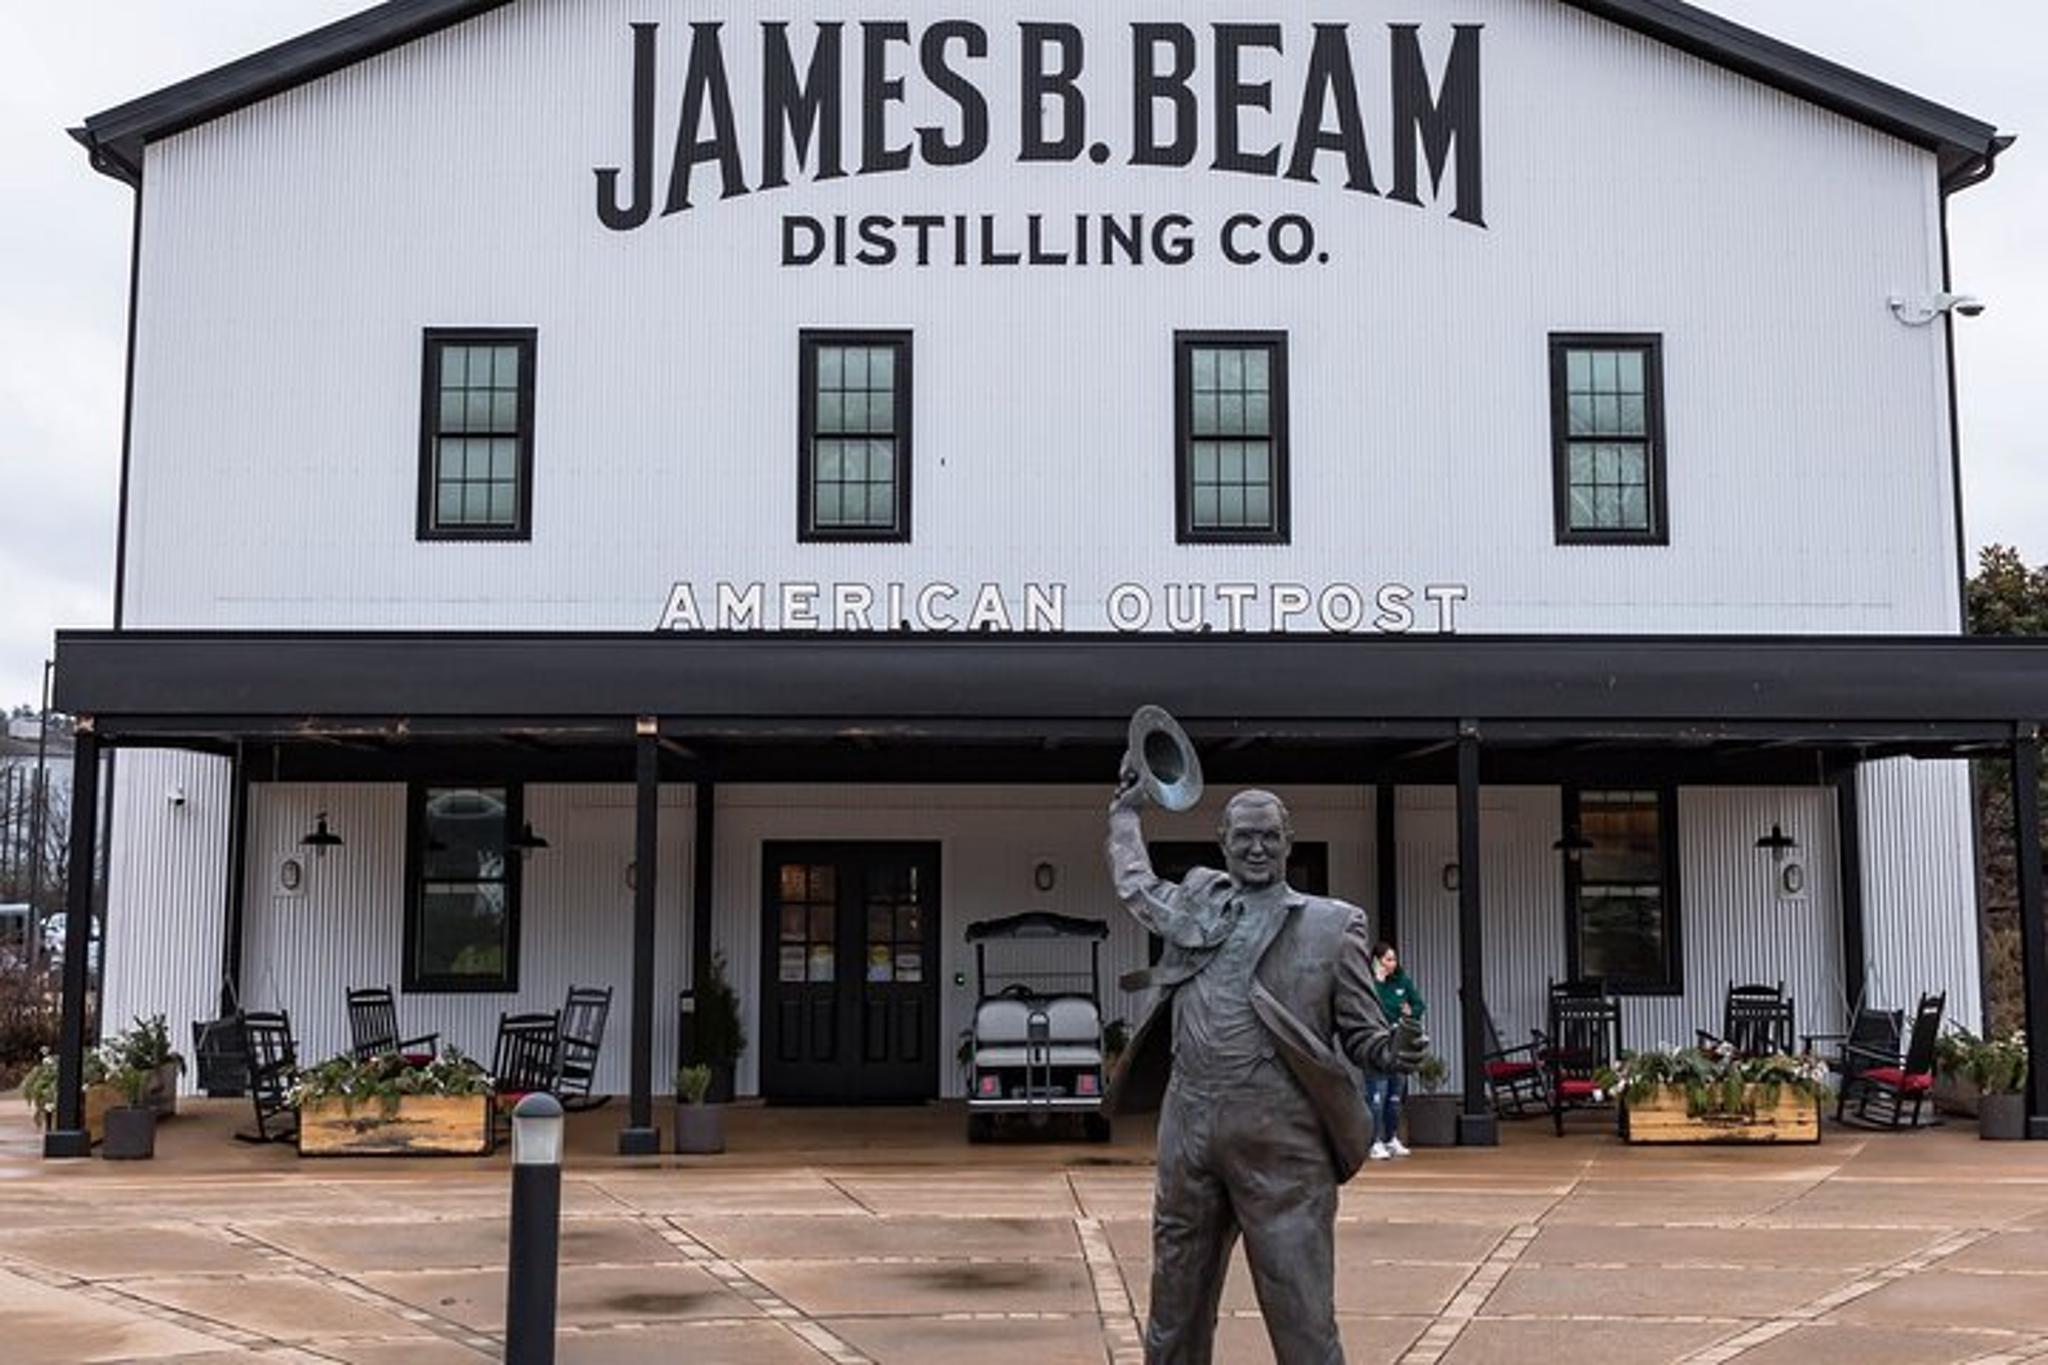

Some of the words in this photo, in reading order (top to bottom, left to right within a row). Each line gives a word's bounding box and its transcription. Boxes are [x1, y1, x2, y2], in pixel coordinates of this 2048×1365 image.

[594, 20, 988, 231] JAMES
[1018, 22, 1110, 166] B.
[1128, 22, 1488, 229] BEAM
[782, 215, 1195, 266] DISTILLING
[1221, 213, 1329, 265] CO.
[655, 582, 1068, 631] AMERICAN
[1107, 583, 1469, 633] OUTPOST
